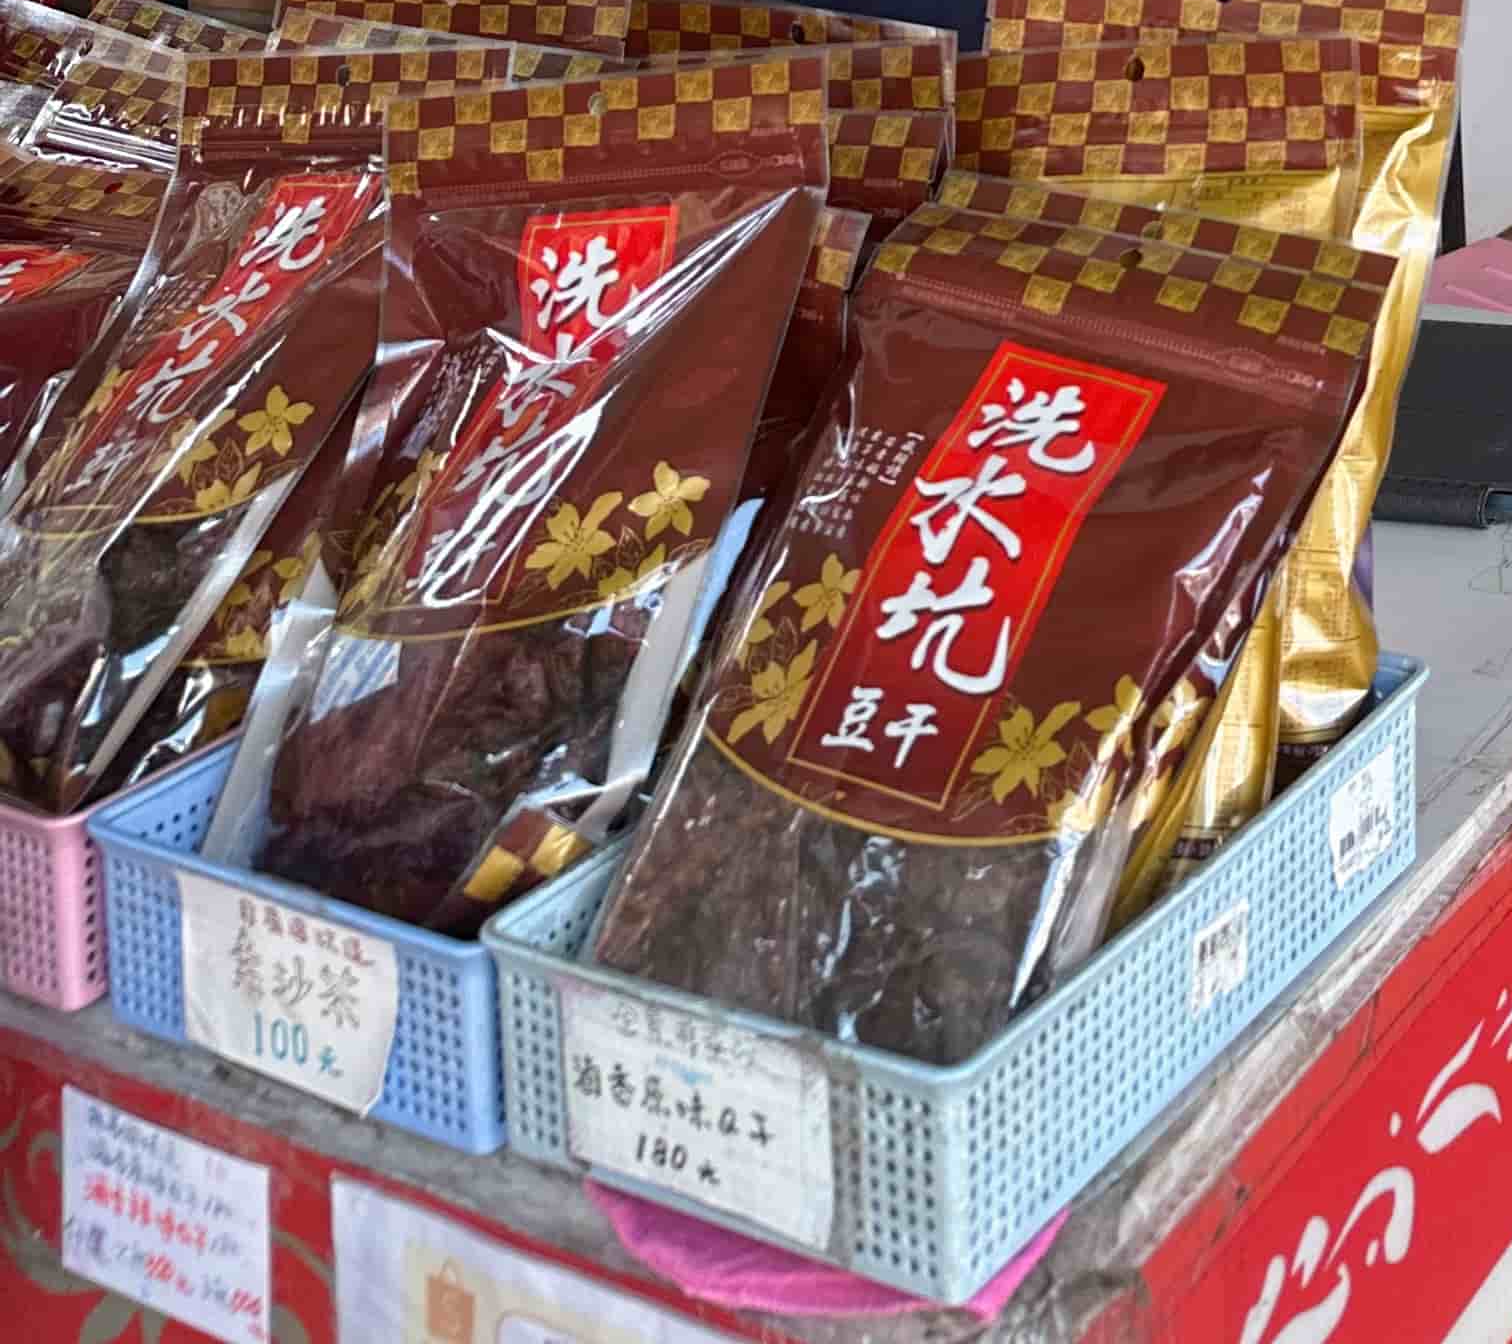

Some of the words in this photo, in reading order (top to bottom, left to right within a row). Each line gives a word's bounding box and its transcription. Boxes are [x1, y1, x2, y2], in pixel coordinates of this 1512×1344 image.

[128, 196, 326, 423] 洗水坑
[874, 377, 1096, 694] 洗水坑
[820, 686, 941, 769] 豆干
